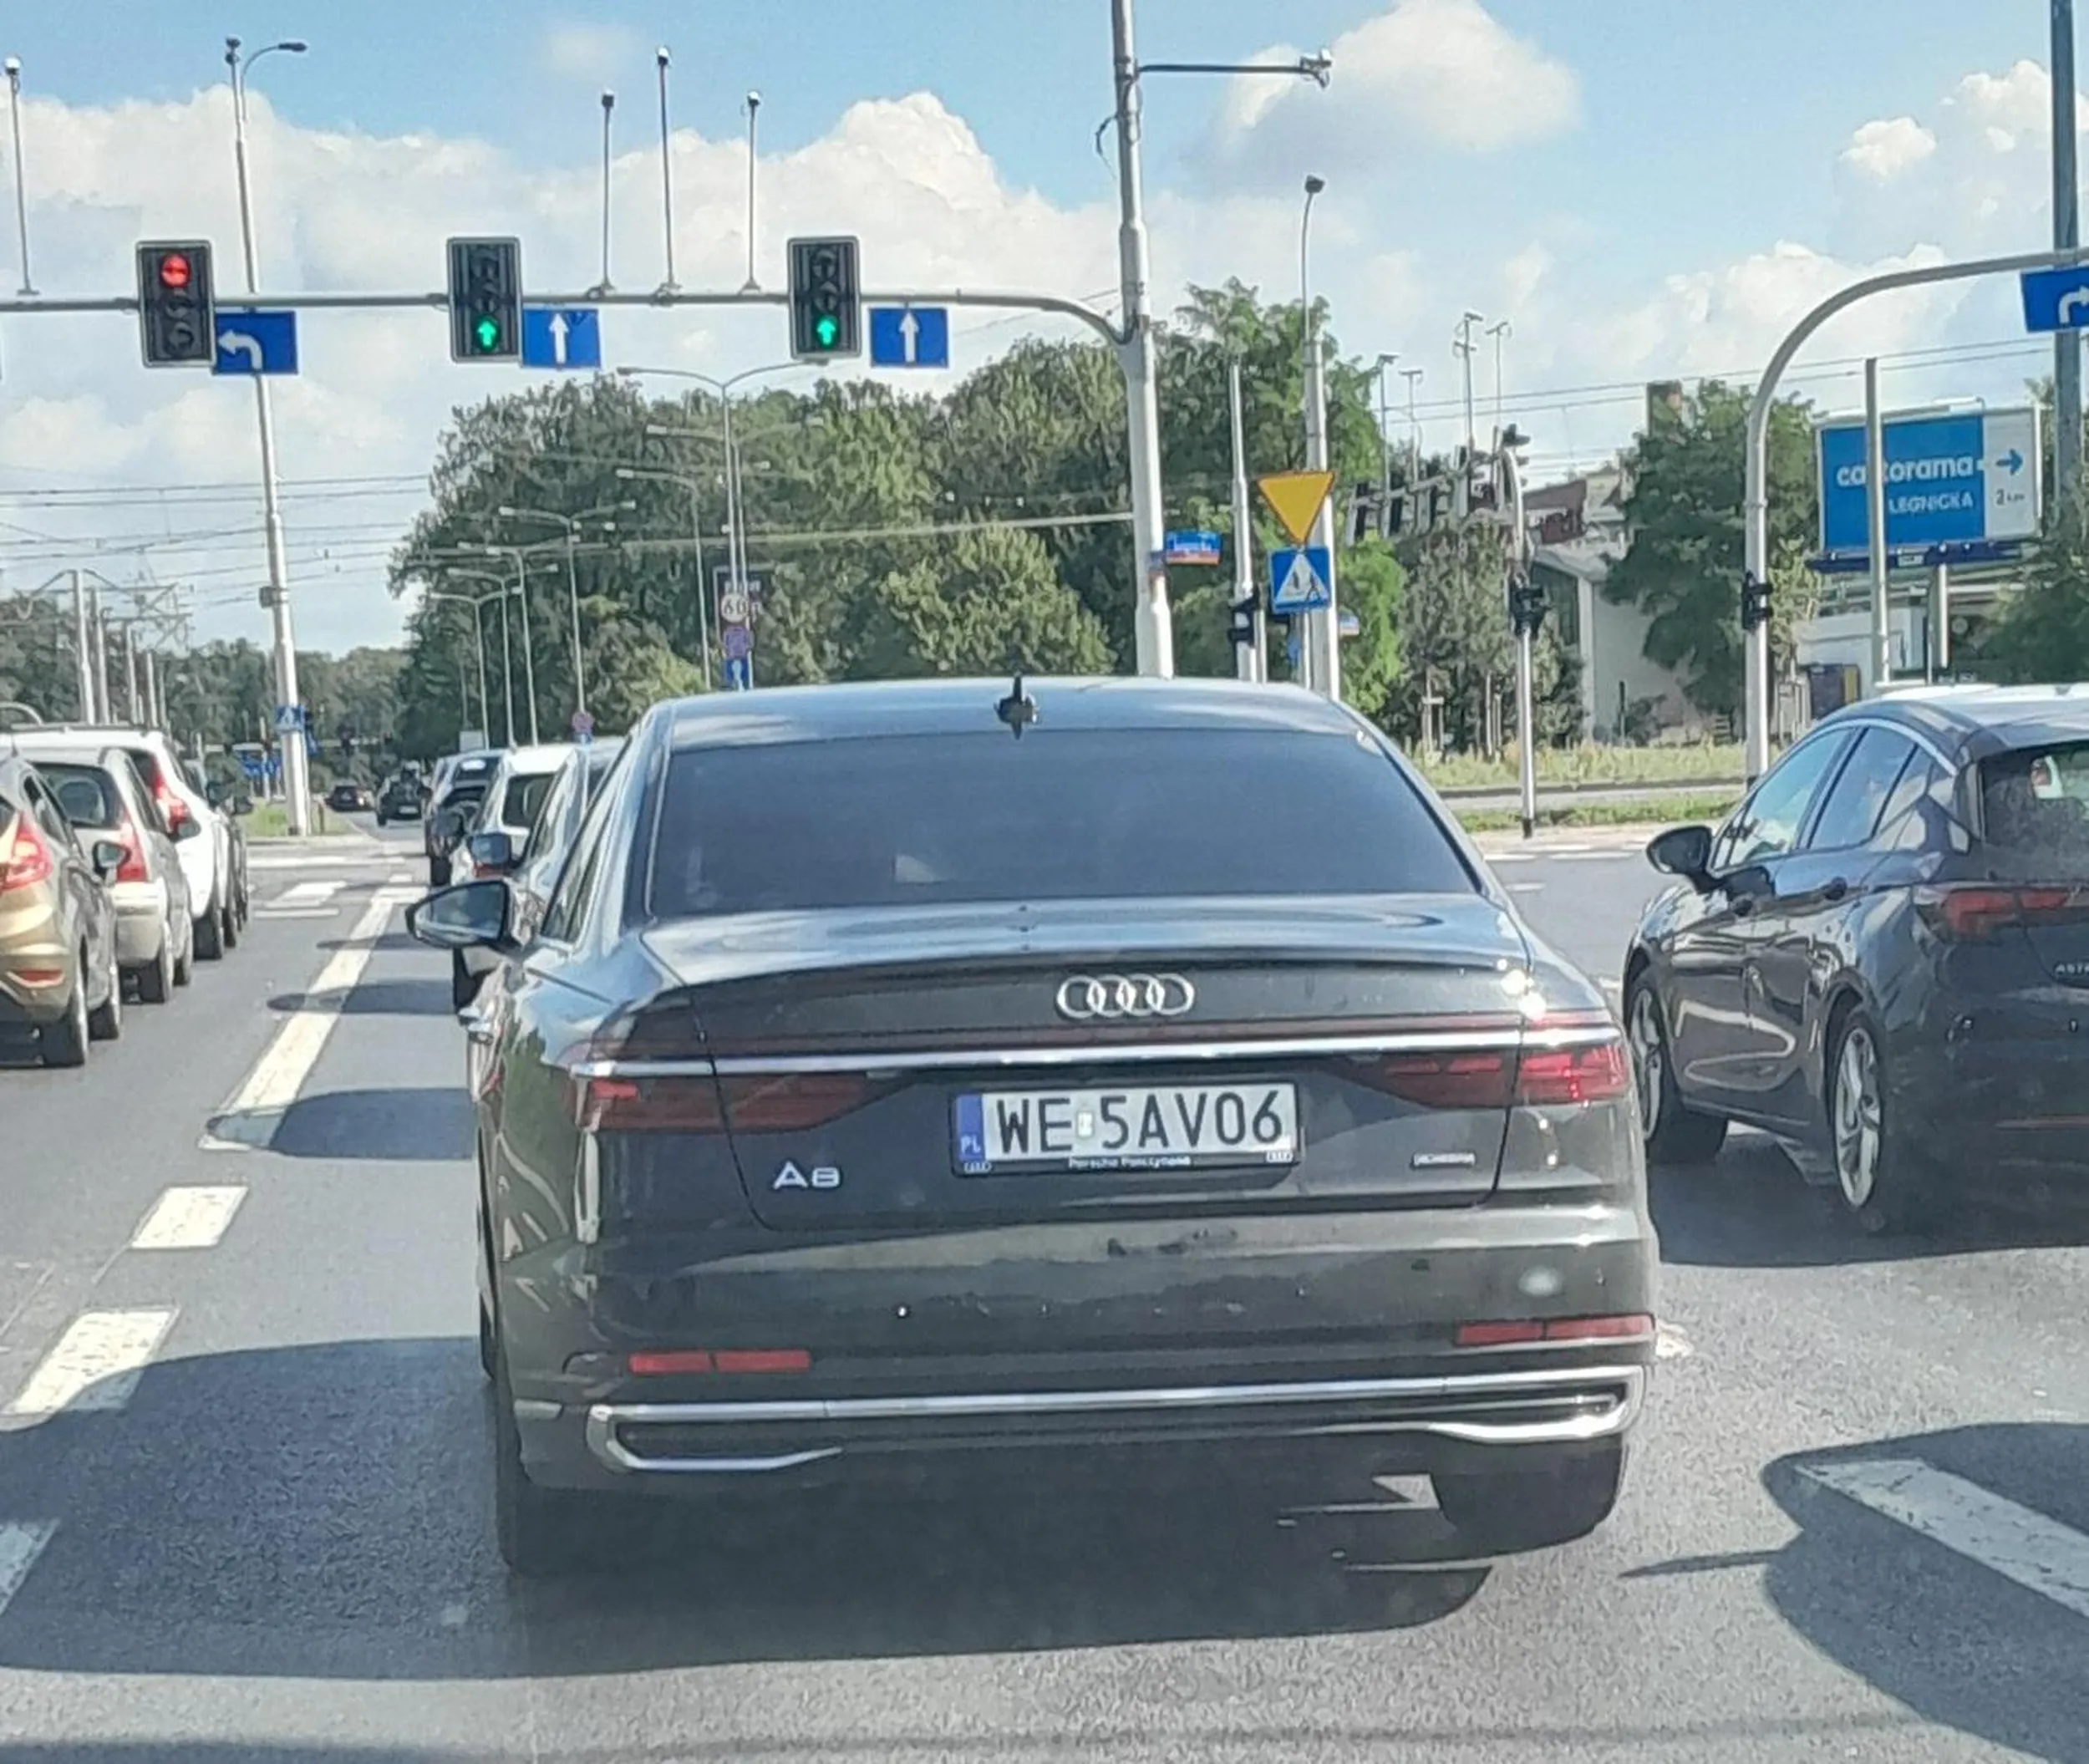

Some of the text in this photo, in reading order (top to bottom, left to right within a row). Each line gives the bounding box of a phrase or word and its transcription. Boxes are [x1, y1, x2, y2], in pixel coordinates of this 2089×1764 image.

[1837, 455, 1974, 487] caorama
[1888, 491, 1974, 515] LEGNICKA
[1995, 488, 2005, 506] 2
[724, 598, 747, 615] 60
[997, 1090, 1283, 1155] WE 5AV06
[961, 1136, 982, 1154] PL
[773, 1160, 841, 1190] A8
